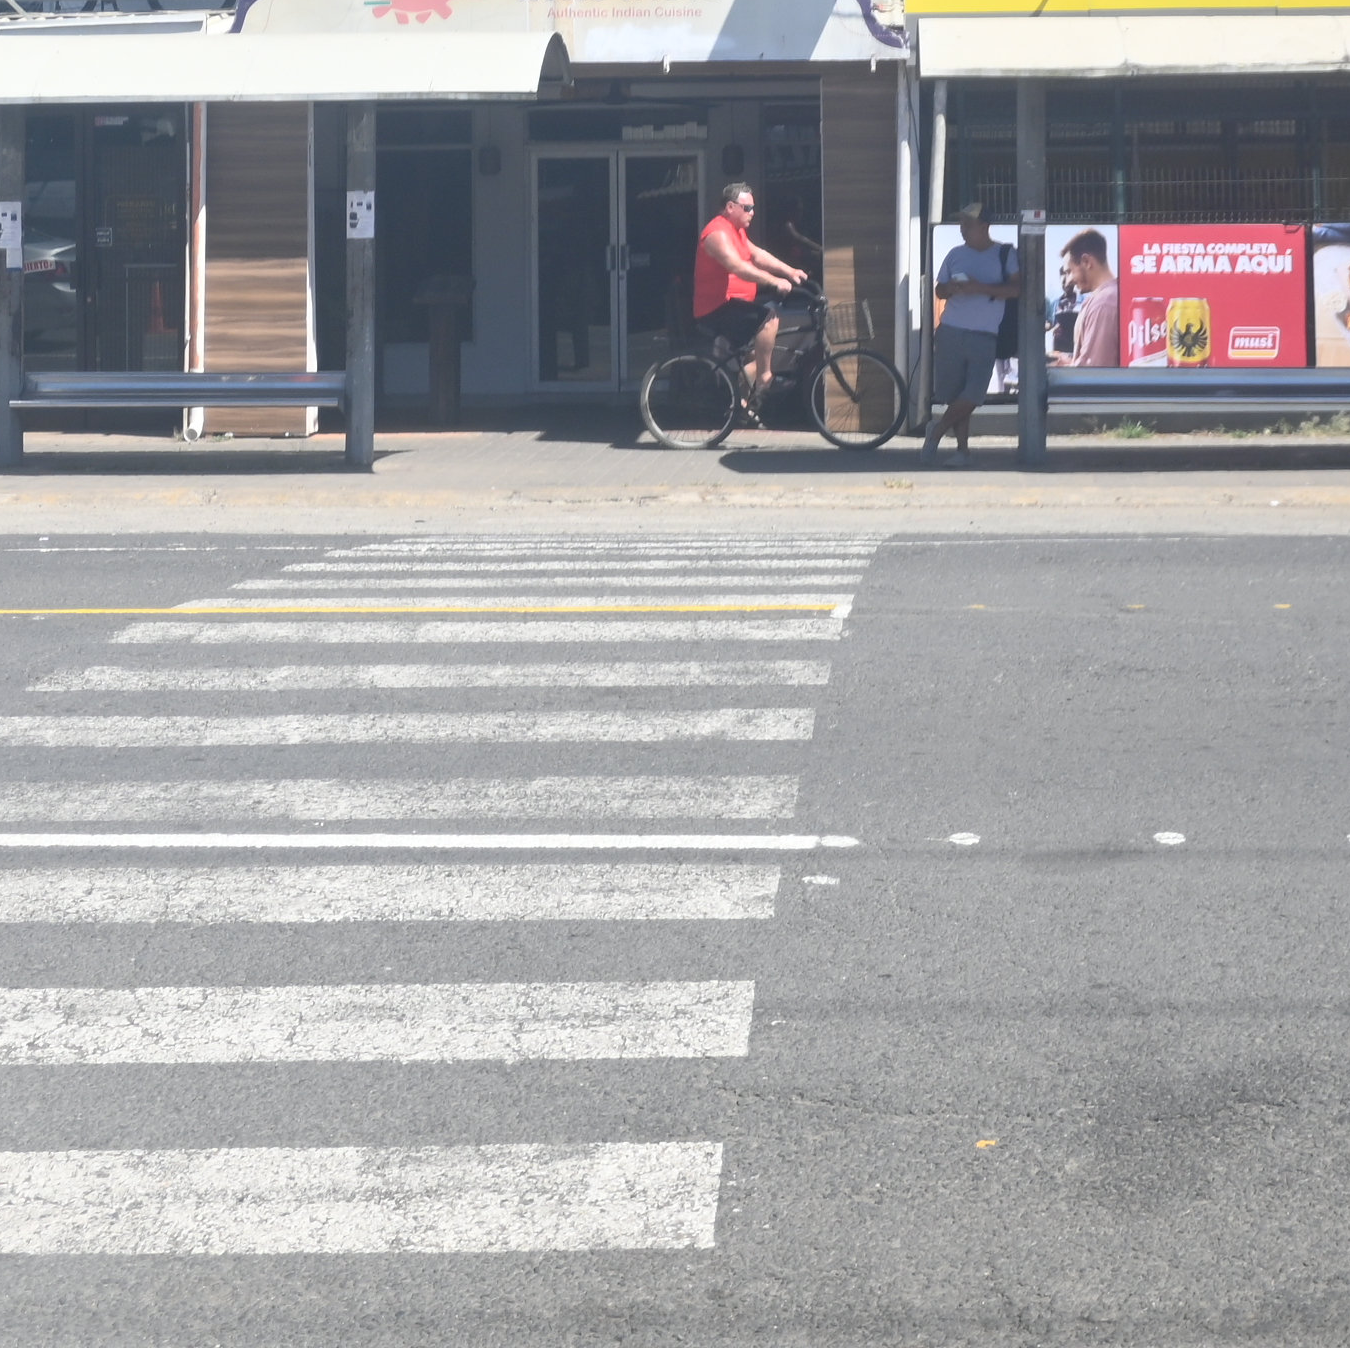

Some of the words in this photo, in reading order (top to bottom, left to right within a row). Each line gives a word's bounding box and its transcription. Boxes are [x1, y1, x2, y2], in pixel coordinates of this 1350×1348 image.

[547, 7, 608, 19] Authentic
[612, 7, 652, 18] Indian
[654, 6, 702, 18] Cuisine
[1143, 243, 1162, 255] LA
[1162, 243, 1202, 255] FIESTA
[1206, 243, 1278, 255] COMPLETA
[1130, 255, 1157, 274] SE
[1159, 255, 1232, 274] ARMA
[1234, 249, 1293, 275] AQUÍ
[1234, 332, 1275, 349] musi
